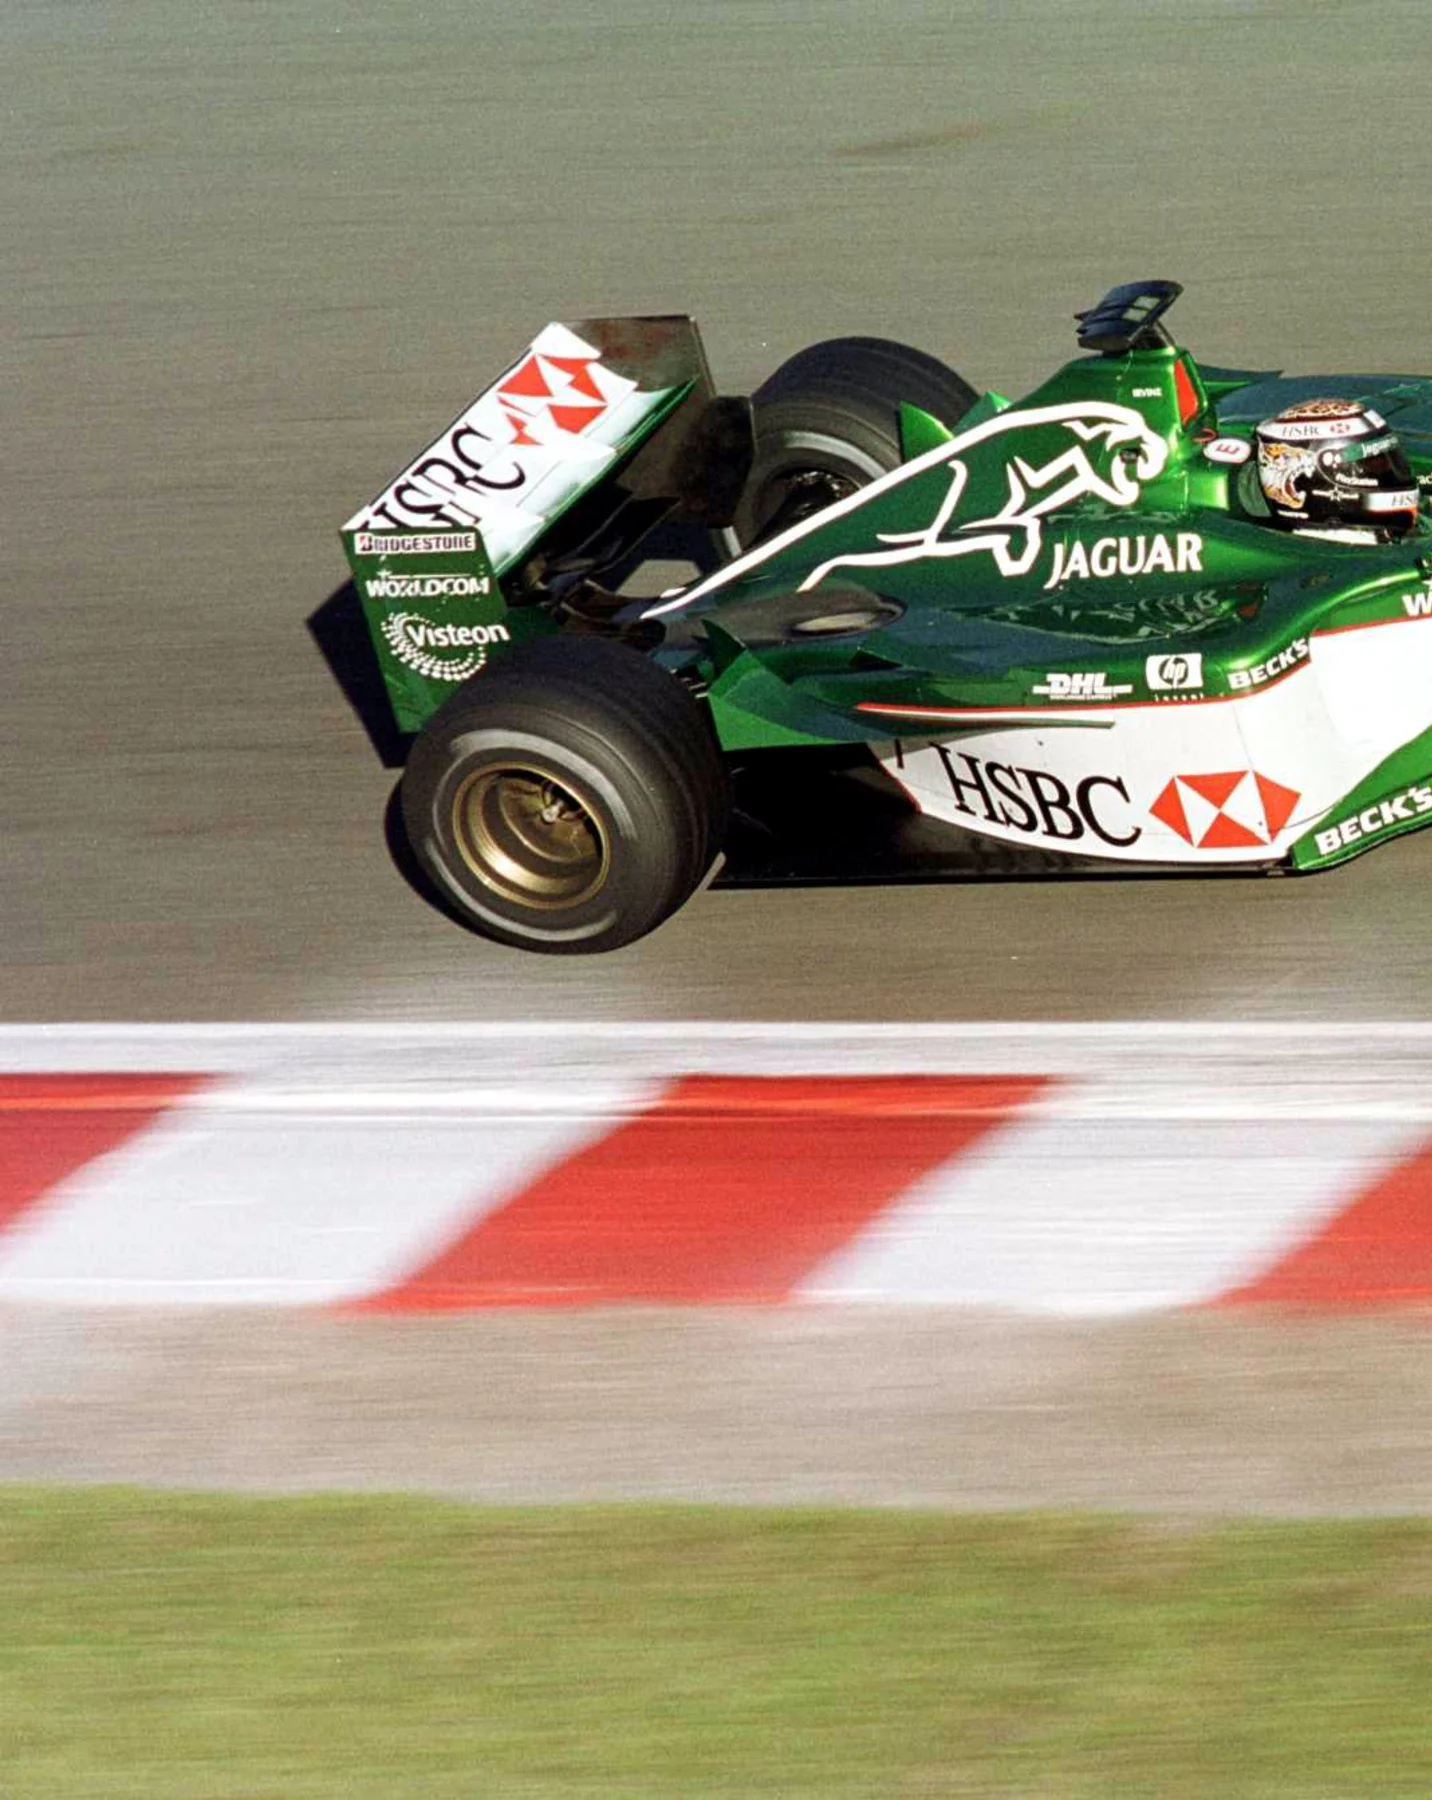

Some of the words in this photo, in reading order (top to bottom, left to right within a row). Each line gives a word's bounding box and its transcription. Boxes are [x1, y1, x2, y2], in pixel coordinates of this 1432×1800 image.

[1043, 532, 1203, 589] JAGUAR
[365, 577, 490, 598] WORLDCOM
[405, 622, 511, 647] Visteon
[1227, 637, 1311, 689] BECK'S
[1046, 673, 1113, 695] DHL
[930, 742, 1142, 847] HSBC
